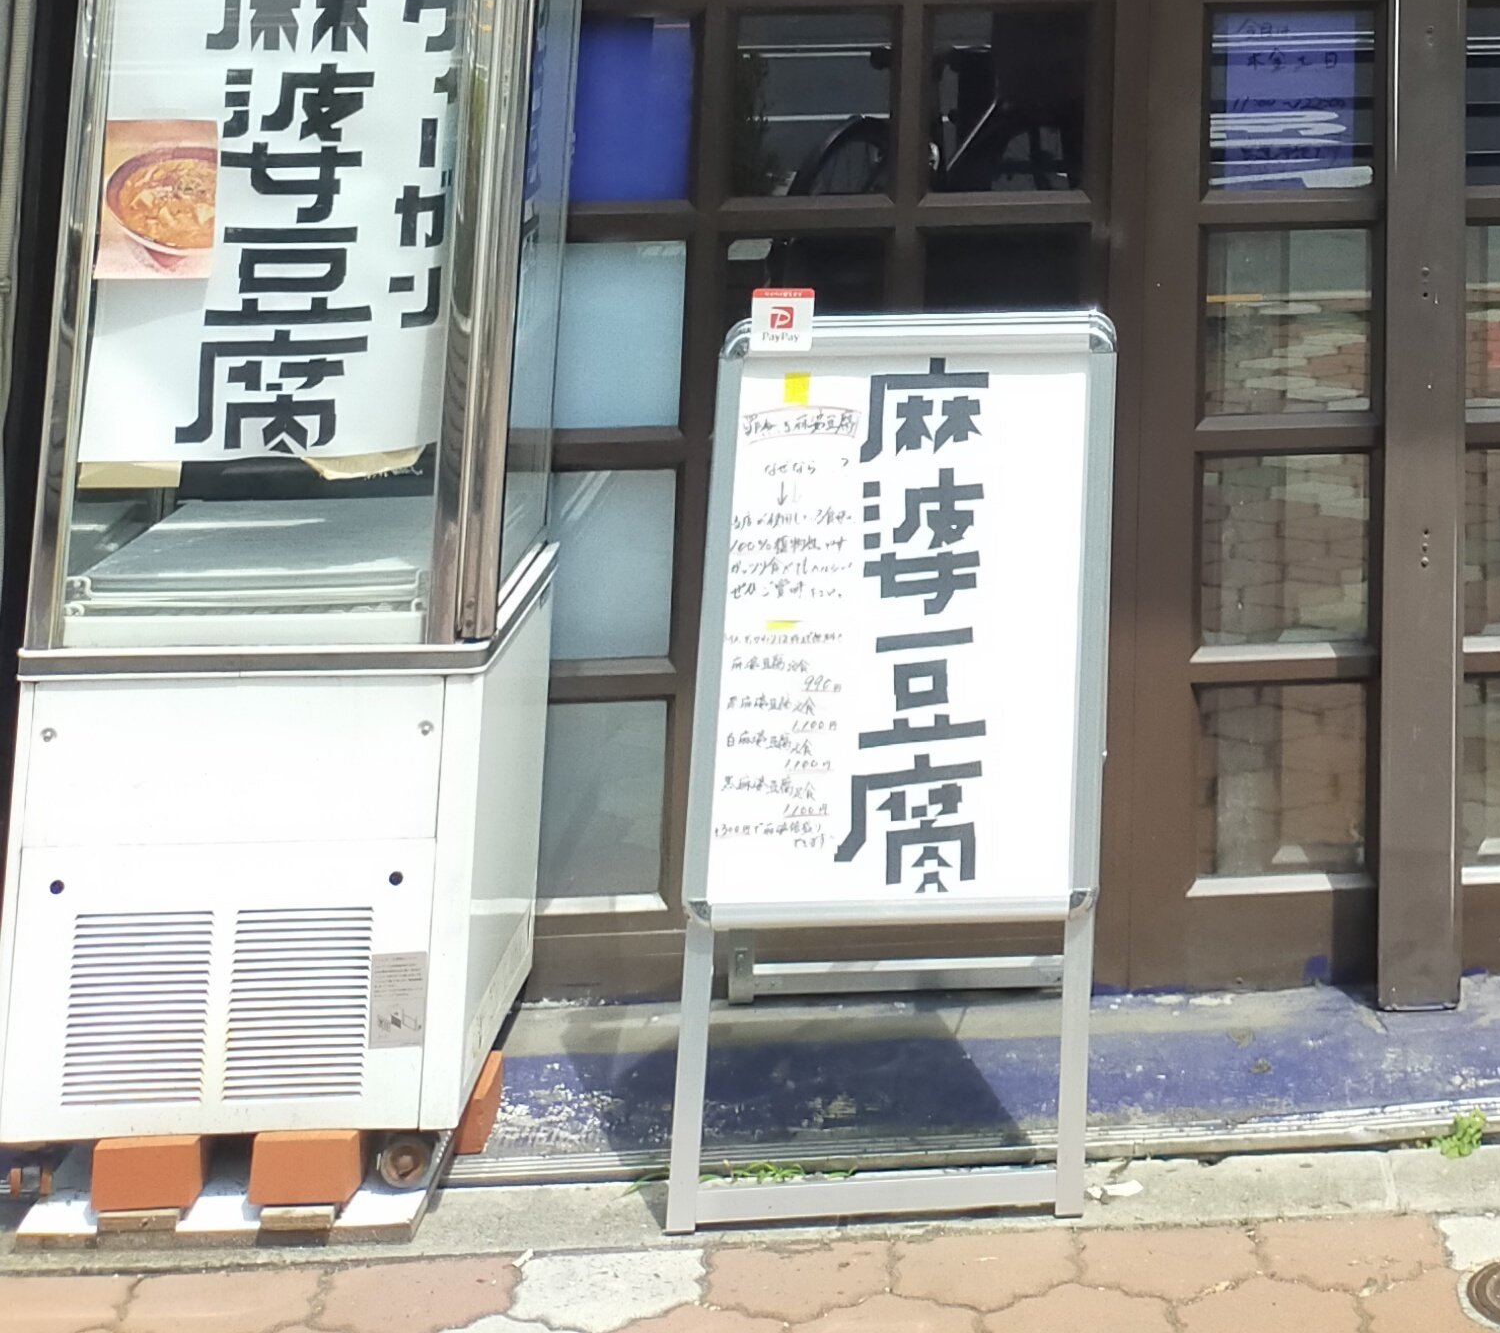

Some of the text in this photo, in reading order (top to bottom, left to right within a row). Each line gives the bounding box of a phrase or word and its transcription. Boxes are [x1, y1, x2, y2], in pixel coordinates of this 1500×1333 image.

[762, 332, 799, 343] PayPay
[833, 357, 990, 894] 麻婆豆腐
